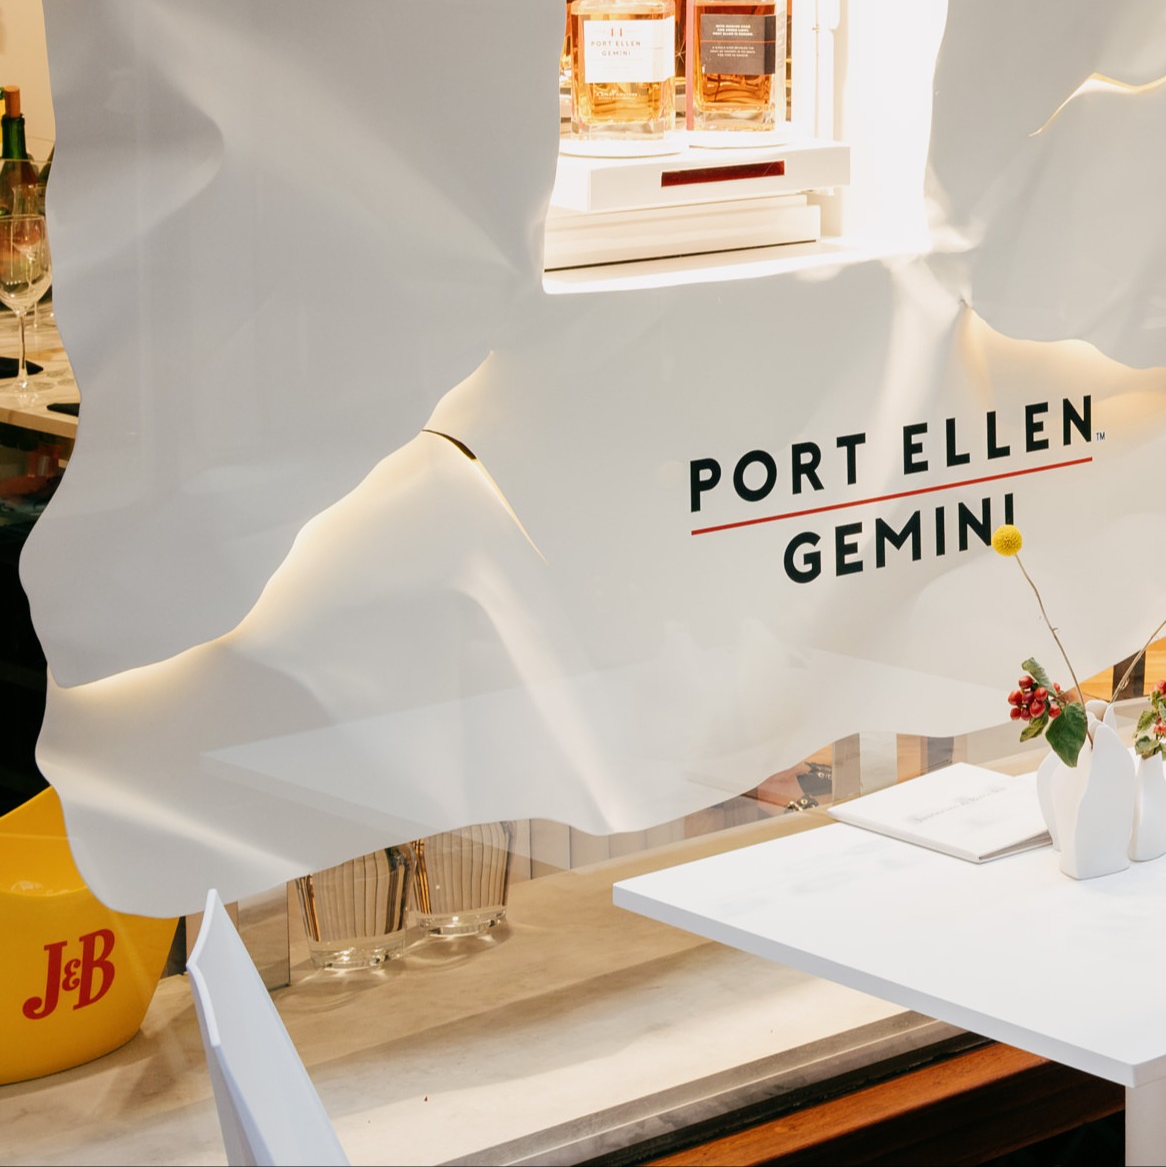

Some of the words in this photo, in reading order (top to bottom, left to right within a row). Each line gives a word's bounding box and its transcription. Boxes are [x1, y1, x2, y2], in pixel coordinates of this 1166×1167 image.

[690, 432, 866, 513] PORT
[903, 394, 1092, 475] ELLEN
[783, 493, 1015, 584] GEMINI
[22, 928, 116, 1020] J&B
